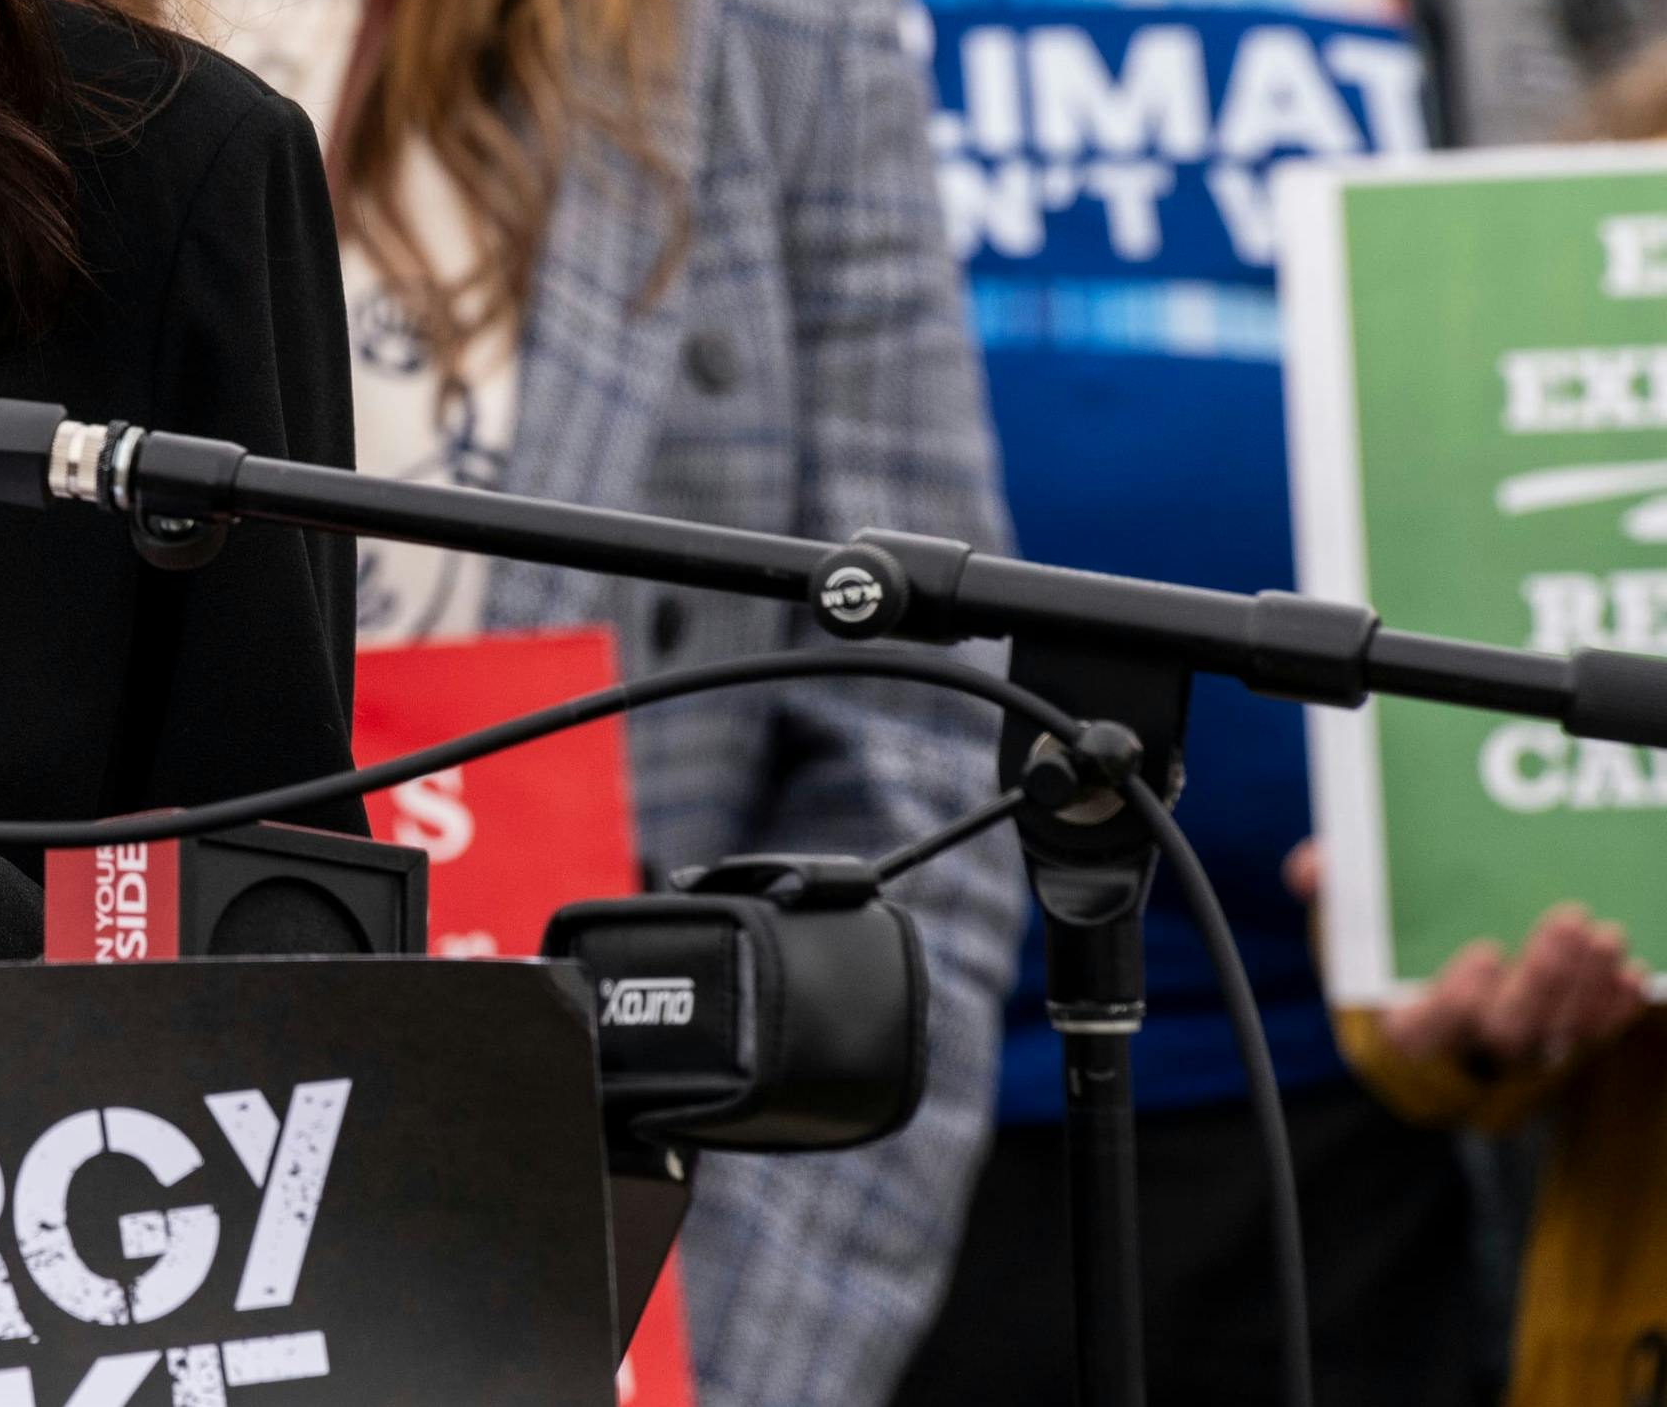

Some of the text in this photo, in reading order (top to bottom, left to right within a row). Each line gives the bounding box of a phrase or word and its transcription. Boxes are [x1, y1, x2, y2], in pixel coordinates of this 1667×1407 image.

[1497, 347, 1667, 432] EX
[1478, 719, 1667, 812] CA
[114, 842, 149, 960] SIDE
